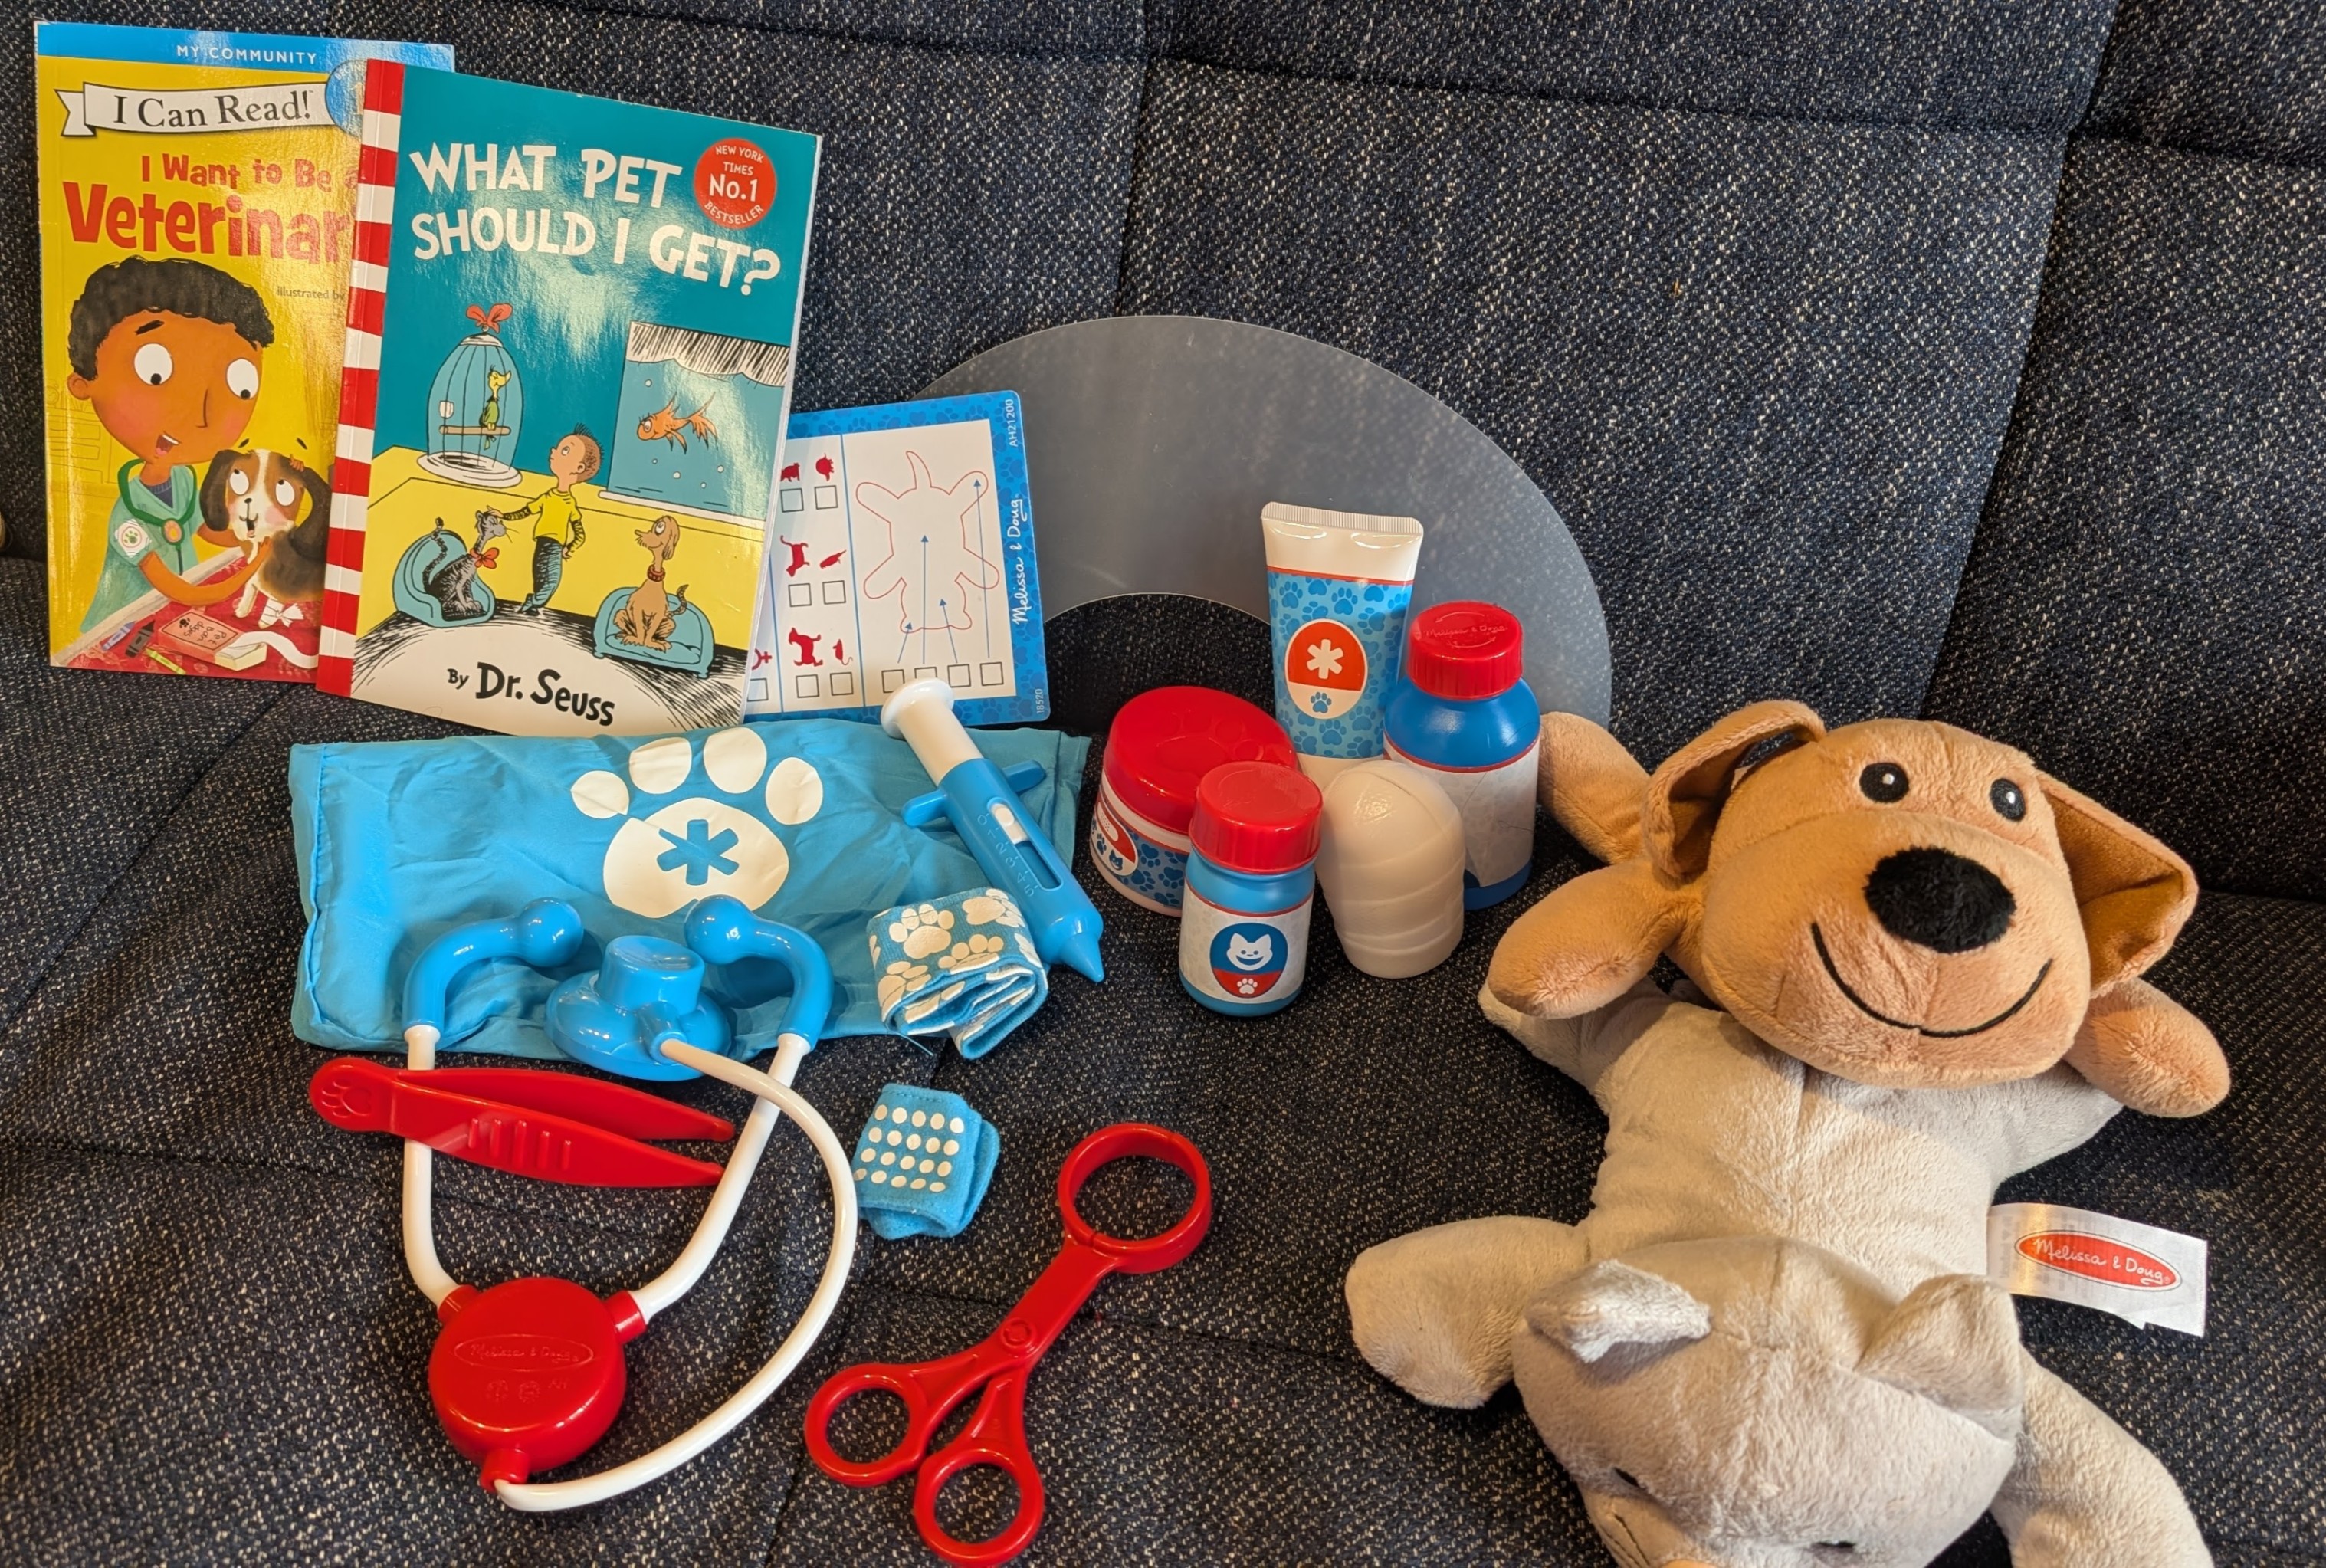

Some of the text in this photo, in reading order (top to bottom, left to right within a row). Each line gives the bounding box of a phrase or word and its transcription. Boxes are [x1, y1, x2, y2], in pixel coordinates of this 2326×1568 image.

[176, 45, 317, 64] MY COMMUNITY
[113, 90, 311, 128] I Can Read!
[142, 155, 150, 182] I
[162, 153, 241, 190] Want
[253, 159, 283, 185] to
[295, 159, 332, 192] Be
[716, 145, 764, 163] NEW YORK
[723, 161, 754, 176] TIMES
[409, 142, 683, 209] WHAT PET
[710, 173, 758, 202] No.1
[62, 181, 356, 264] Veterinar
[704, 200, 764, 225] BESTSELLER
[411, 206, 781, 296] SHOULD I GET?
[333, 290, 345, 301] by
[1005, 399, 1018, 448] AH21200
[1012, 556, 1032, 625] Melissa
[208, 630, 228, 645] Pet
[447, 661, 615, 727] By Dr. Seuss
[1035, 688, 1045, 714] 18520
[2032, 1238, 2107, 1266] Melissa
[2113, 1256, 2121, 1269] &
[2125, 1258, 2164, 1285] Doug
